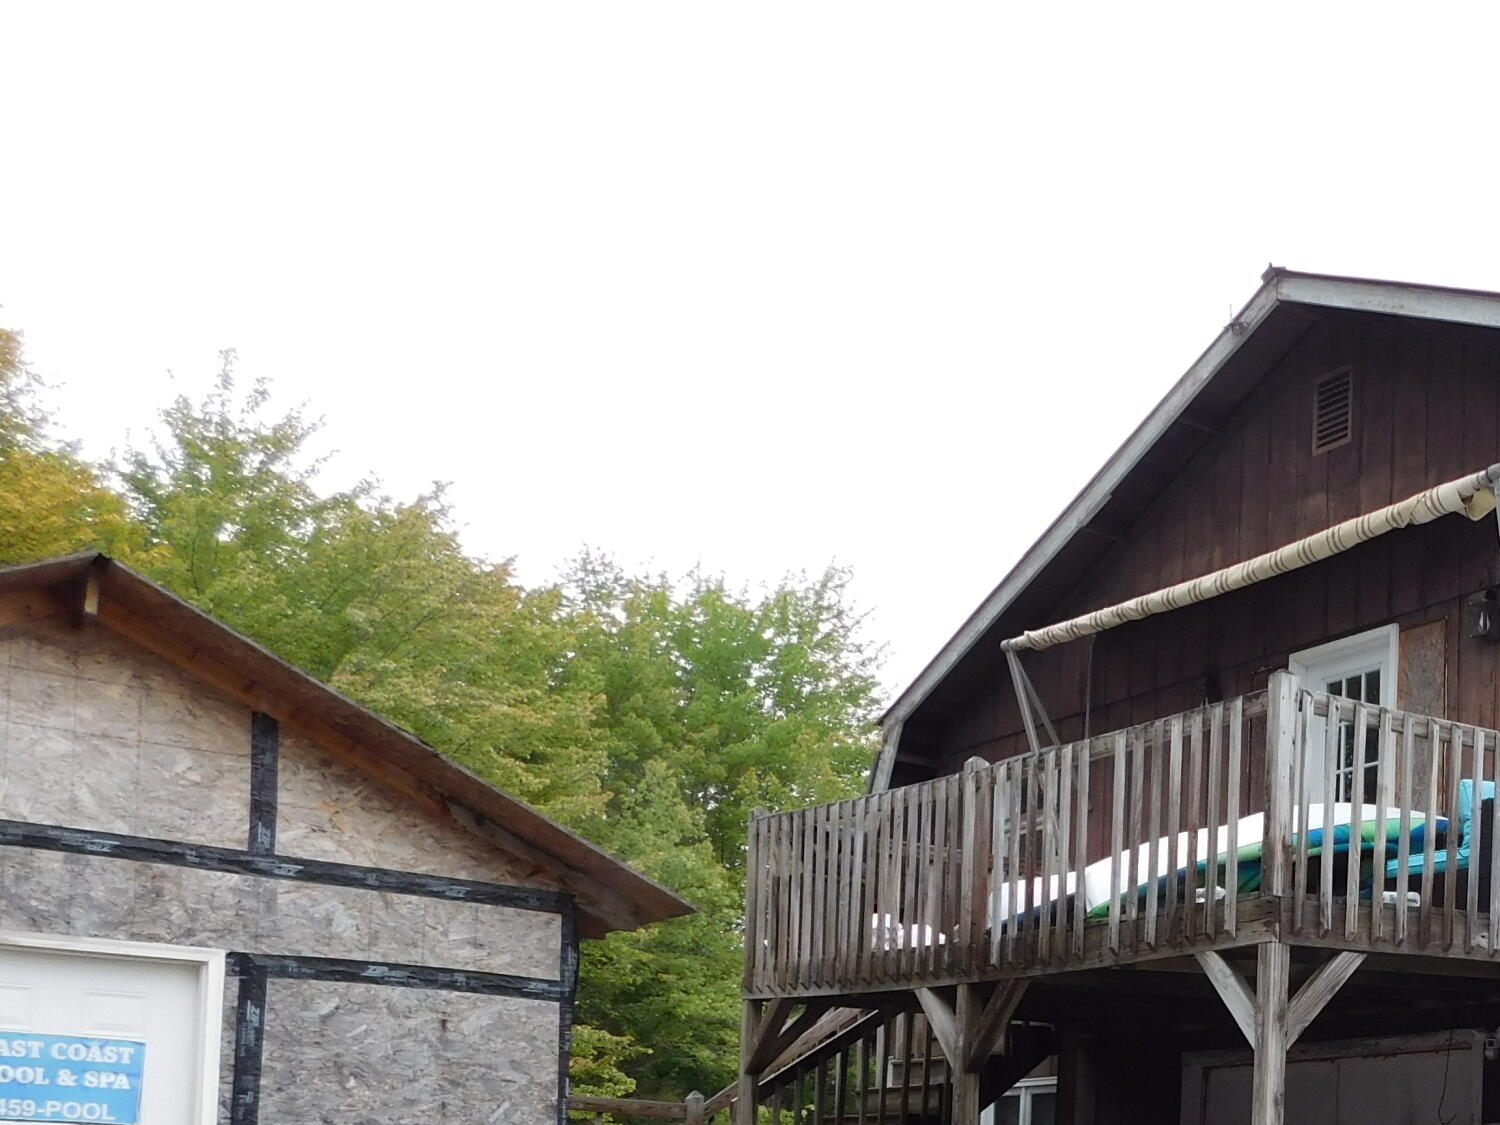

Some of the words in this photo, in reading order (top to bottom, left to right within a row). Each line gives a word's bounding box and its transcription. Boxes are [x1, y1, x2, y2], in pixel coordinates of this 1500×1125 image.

[51, 1041, 135, 1064] COAST
[57, 1068, 79, 1087] &
[83, 1070, 131, 1090] SPA
